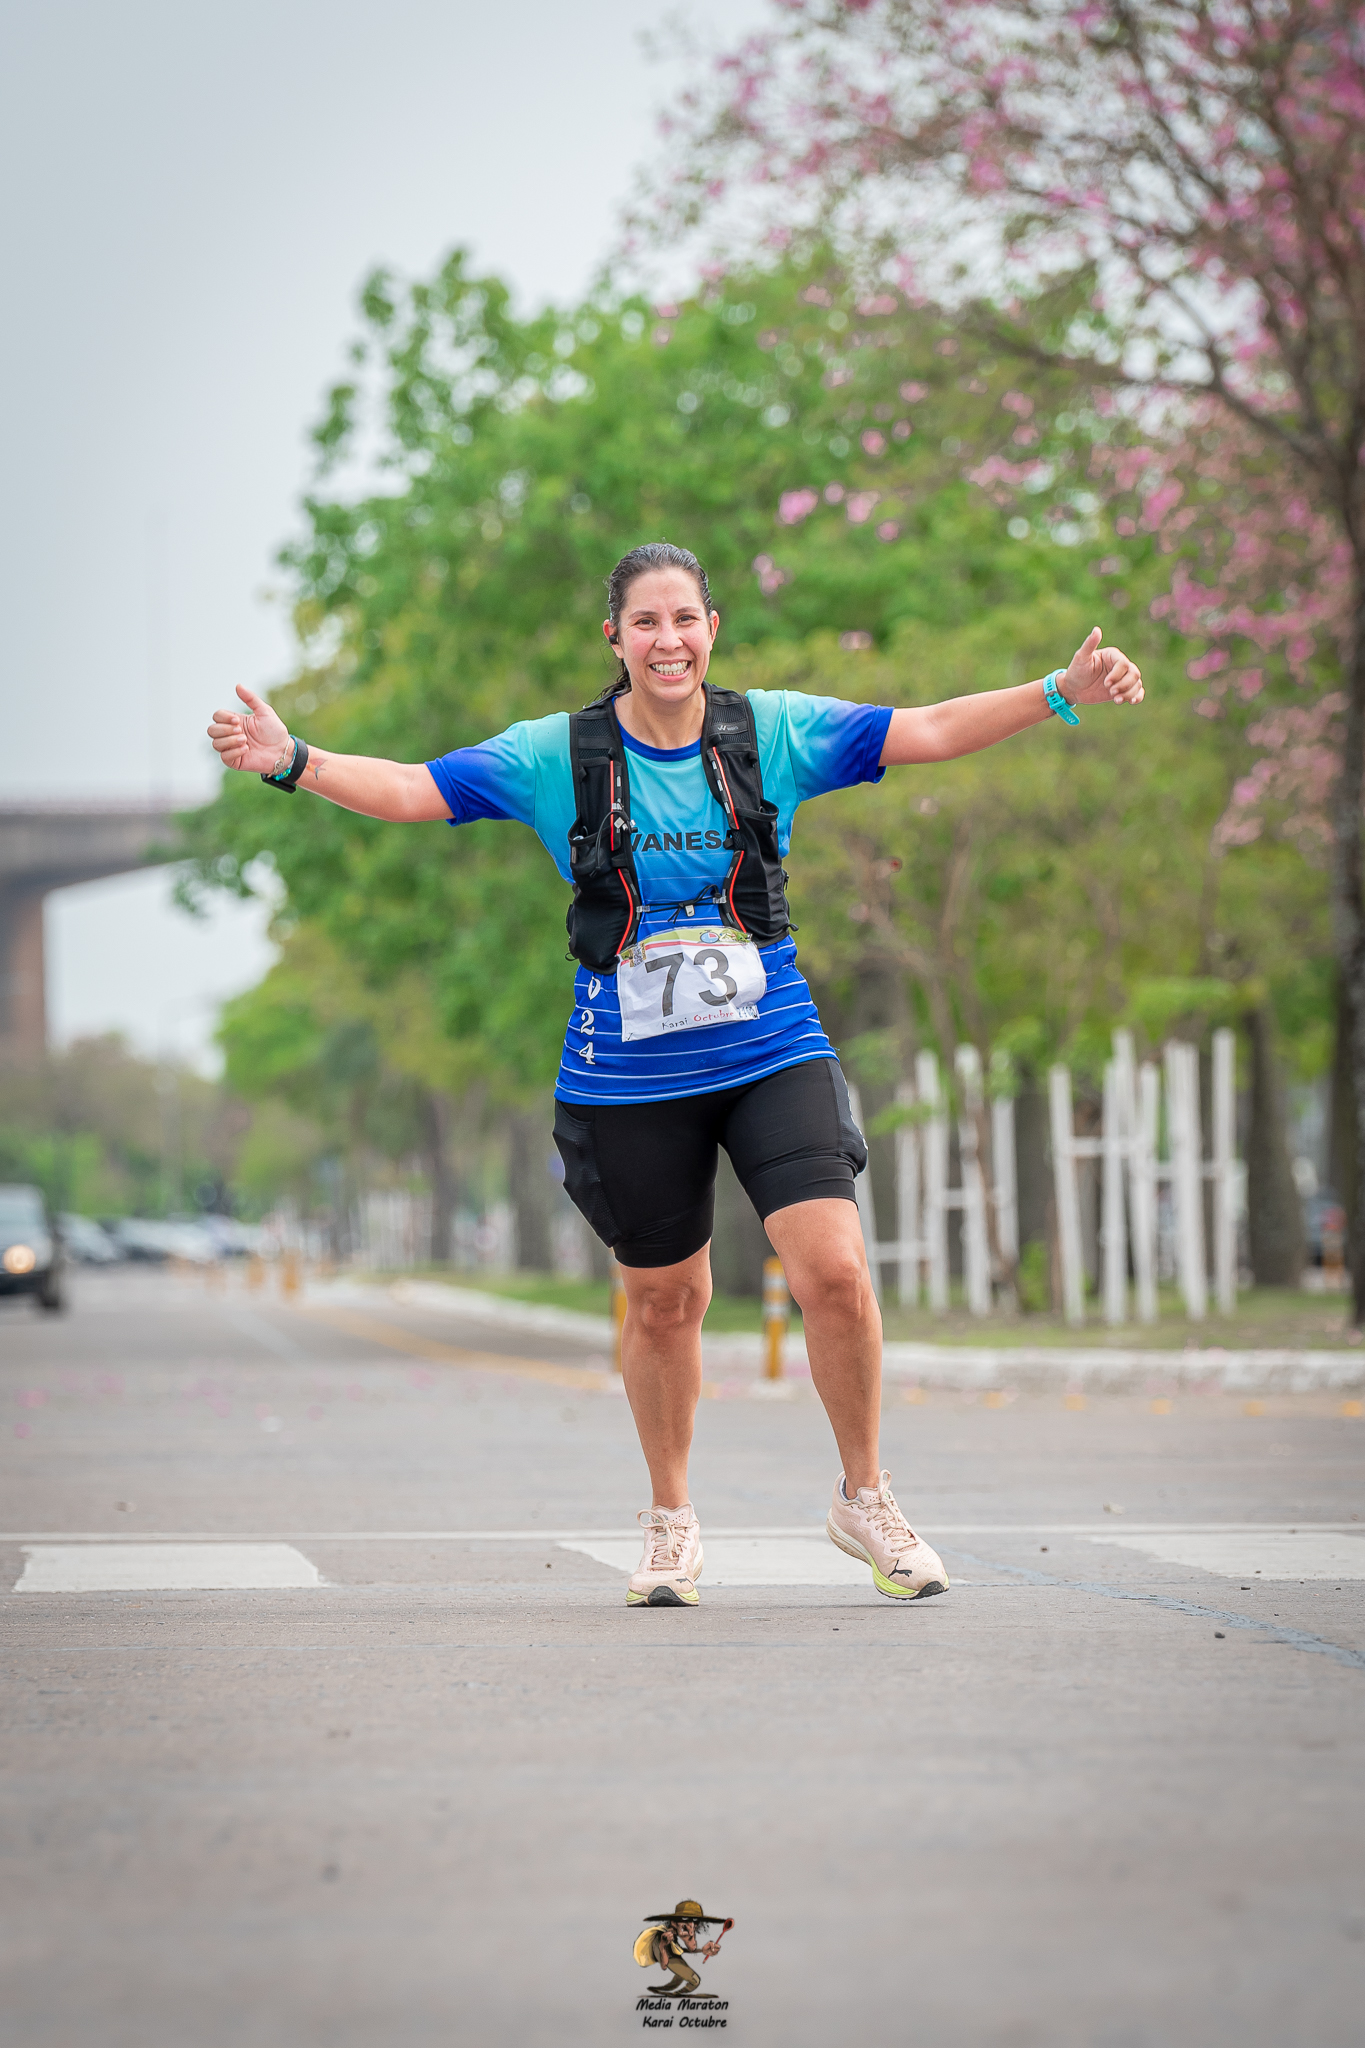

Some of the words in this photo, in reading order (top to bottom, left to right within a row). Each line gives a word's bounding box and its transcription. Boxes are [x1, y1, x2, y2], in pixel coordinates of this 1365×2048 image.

[631, 830, 735, 852] VANES
[644, 948, 738, 1018] 73
[661, 1017, 689, 1031] Karai
[693, 1009, 735, 1023] Octubre
